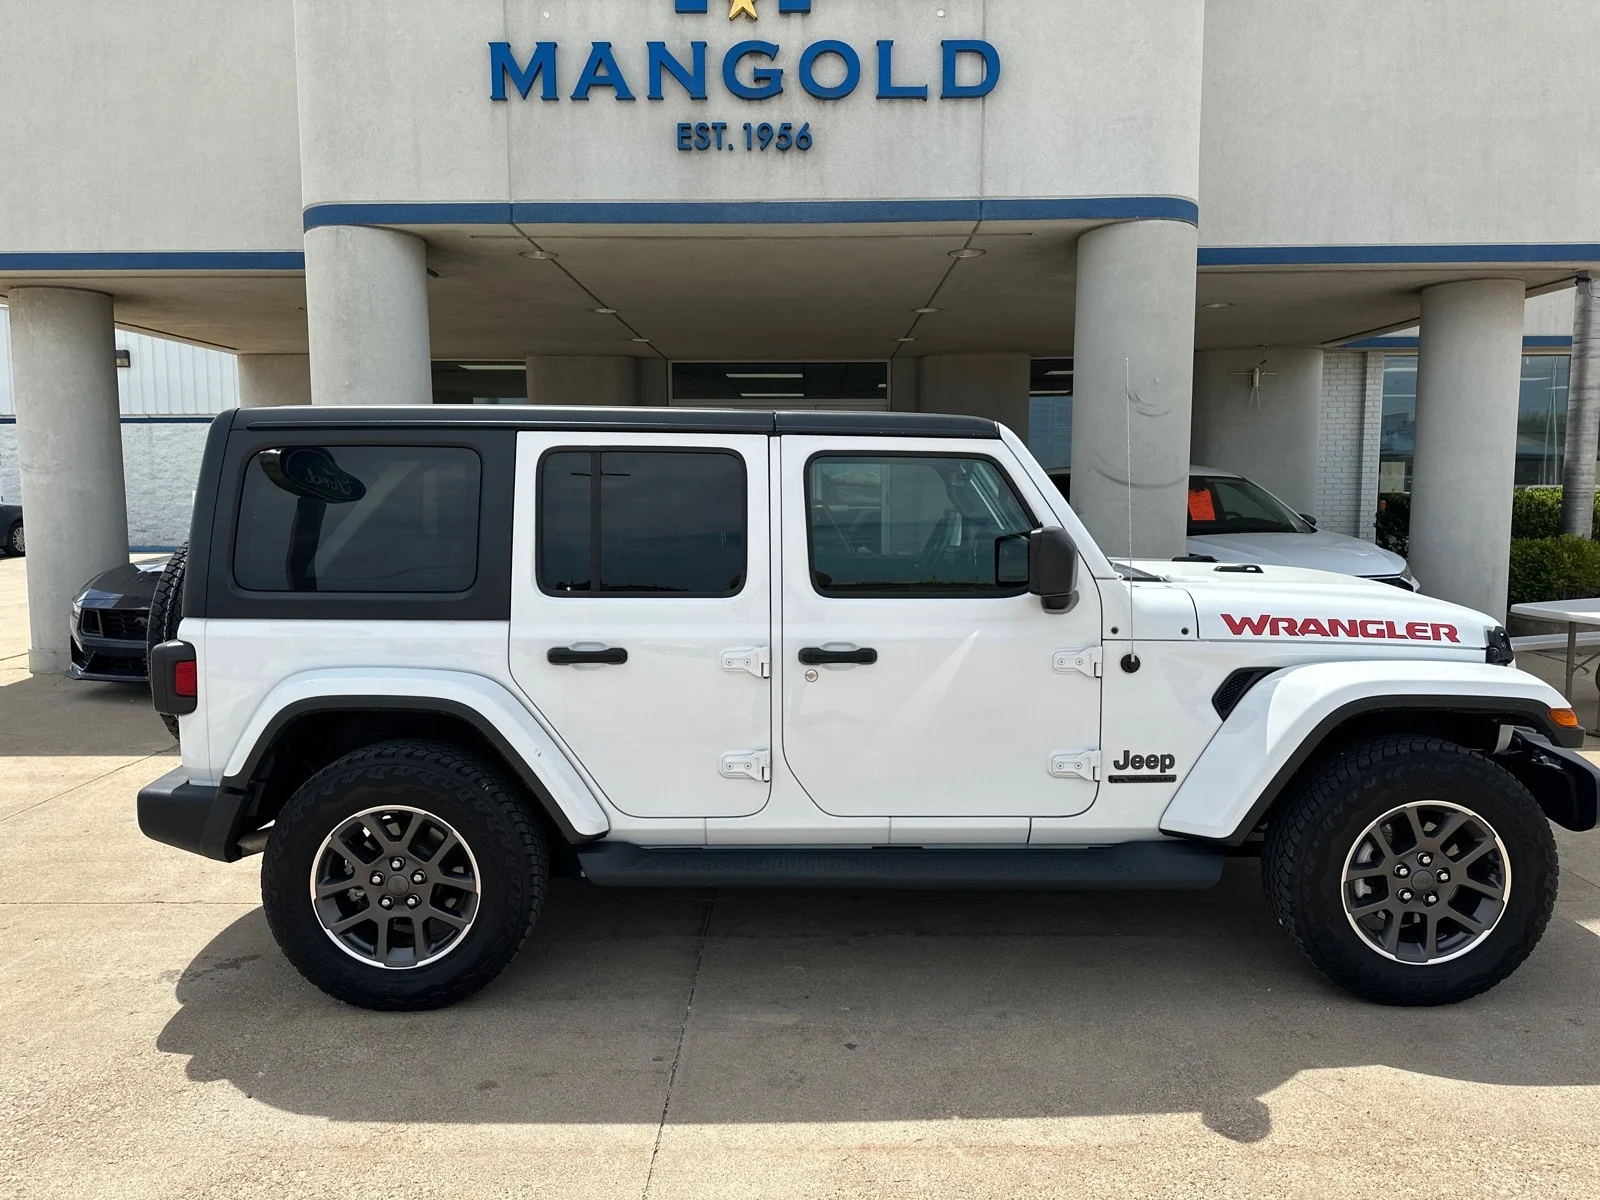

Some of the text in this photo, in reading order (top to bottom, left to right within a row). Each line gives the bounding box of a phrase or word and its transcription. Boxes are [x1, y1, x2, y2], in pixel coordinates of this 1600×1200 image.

[488, 39, 1001, 101] MANGOLD
[677, 122, 813, 151] EST. 1956
[1220, 613, 1460, 643] WRANGLER
[1113, 749, 1176, 774] Jeep
